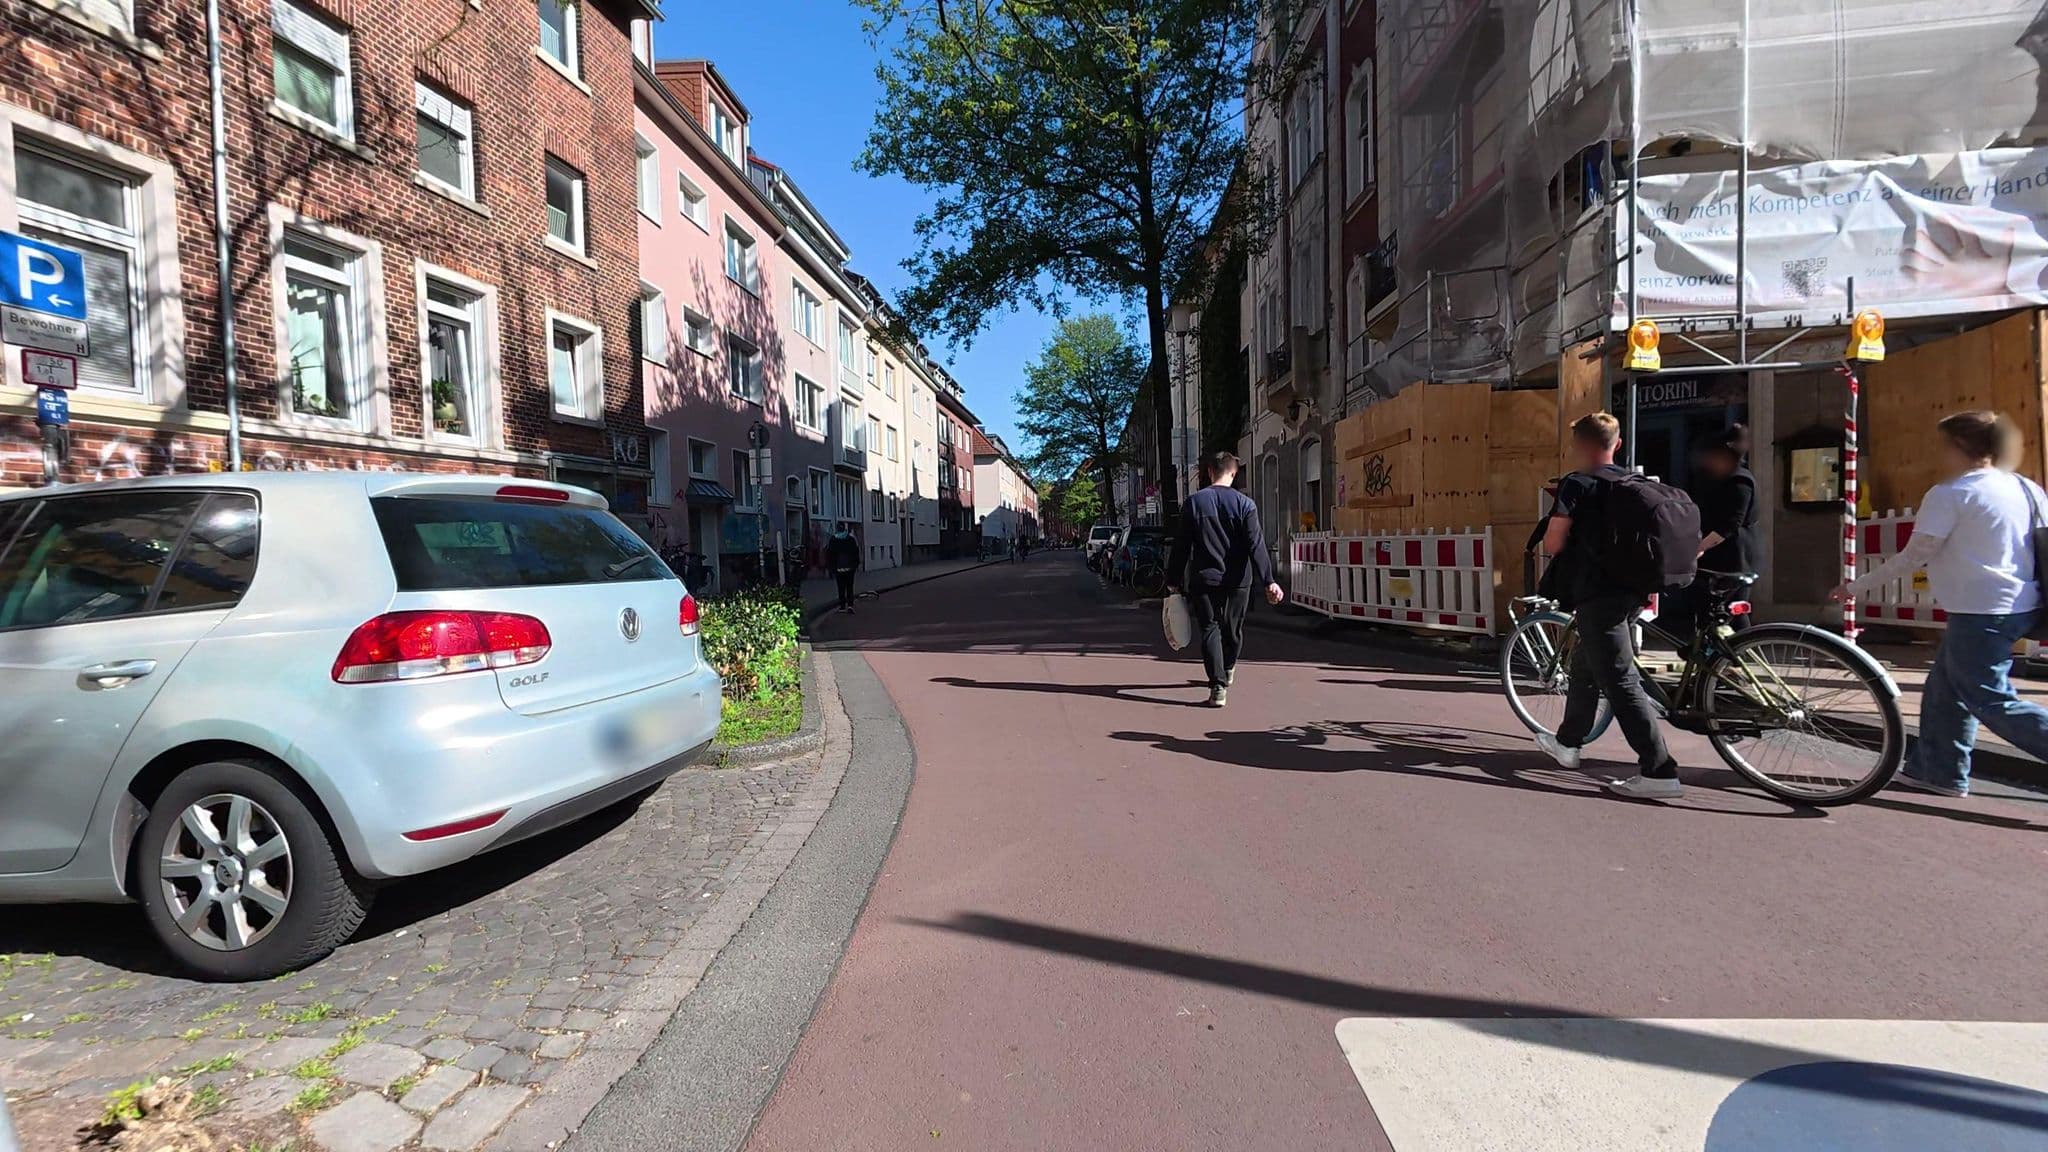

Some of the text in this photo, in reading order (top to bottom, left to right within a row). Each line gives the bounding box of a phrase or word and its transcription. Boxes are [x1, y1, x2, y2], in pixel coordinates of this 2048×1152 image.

[1749, 189, 1872, 214] Kompetenz
[1920, 182, 1975, 200] einer
[16, 244, 65, 301] P
[1638, 273, 1735, 288] einz vorwe
[10, 312, 77, 334] Bewohner
[76, 343, 85, 354] H
[509, 672, 549, 687] GOLF
